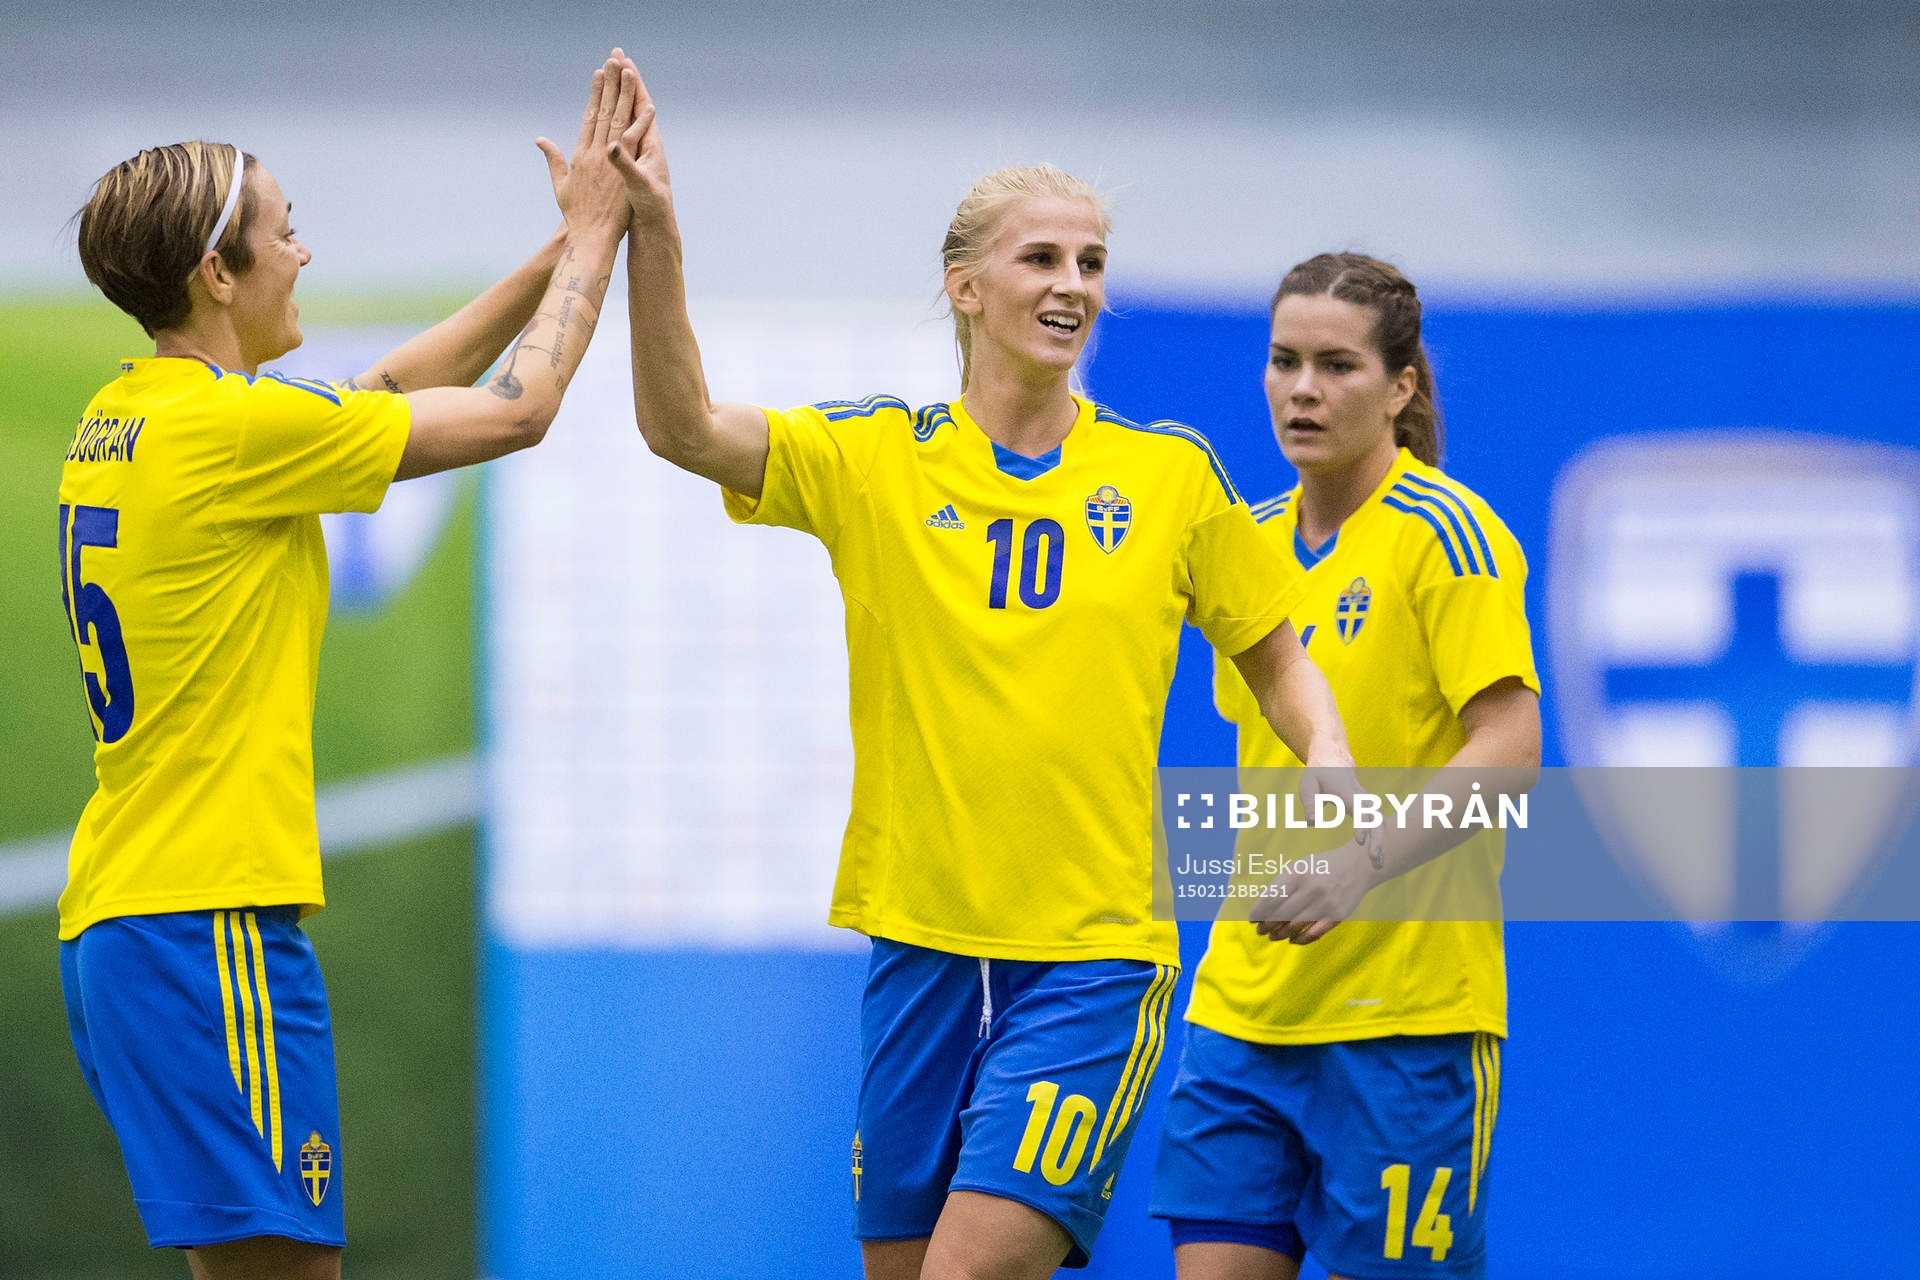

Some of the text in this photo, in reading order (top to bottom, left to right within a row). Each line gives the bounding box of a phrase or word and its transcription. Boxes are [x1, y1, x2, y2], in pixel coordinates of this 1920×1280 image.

[925, 518, 965, 530] adidas
[986, 518, 1065, 609] 10
[1012, 1080, 1098, 1186] 10
[1380, 1163, 1454, 1262] 14
